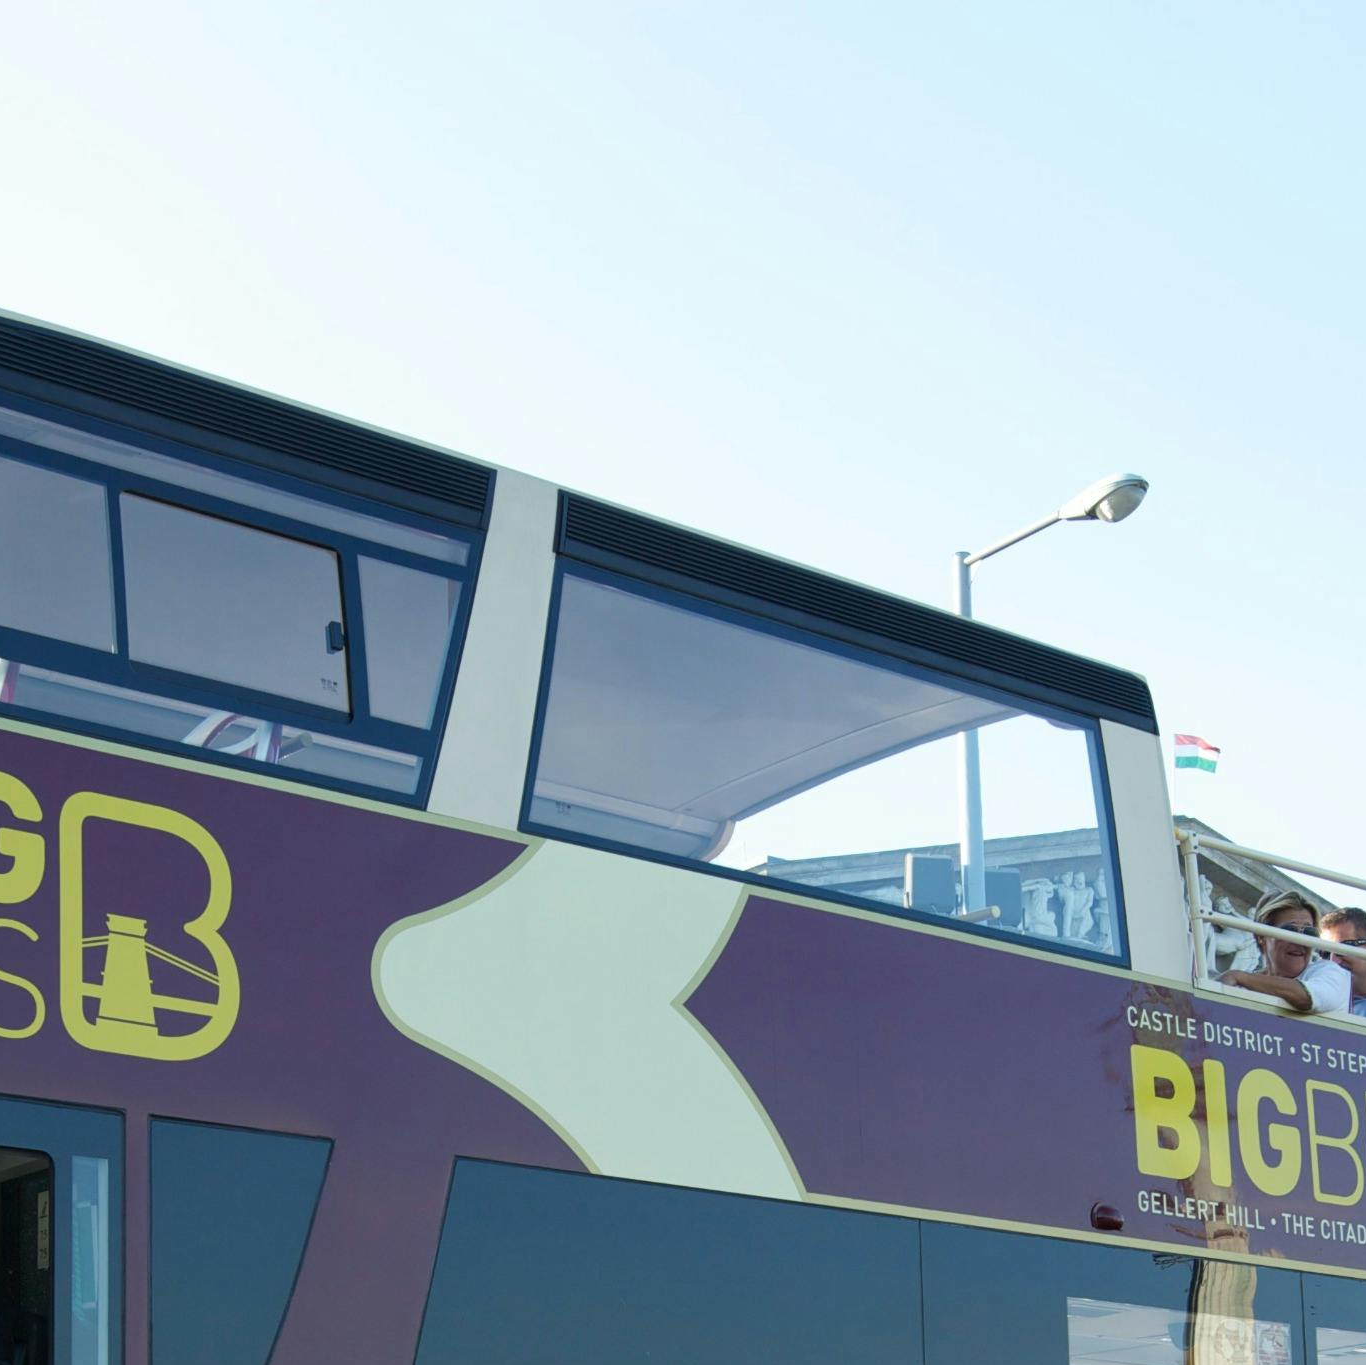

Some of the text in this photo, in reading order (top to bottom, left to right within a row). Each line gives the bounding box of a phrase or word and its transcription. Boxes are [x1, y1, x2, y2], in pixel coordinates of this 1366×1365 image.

[1126, 1005, 1198, 1040] CASTLE
[1203, 1021, 1283, 1057] DISTRICT
[1301, 1042, 1321, 1065] ST
[1137, 1190, 1221, 1222] GELLERT
[1225, 1203, 1266, 1230] HILL
[1281, 1212, 1316, 1238] THE
